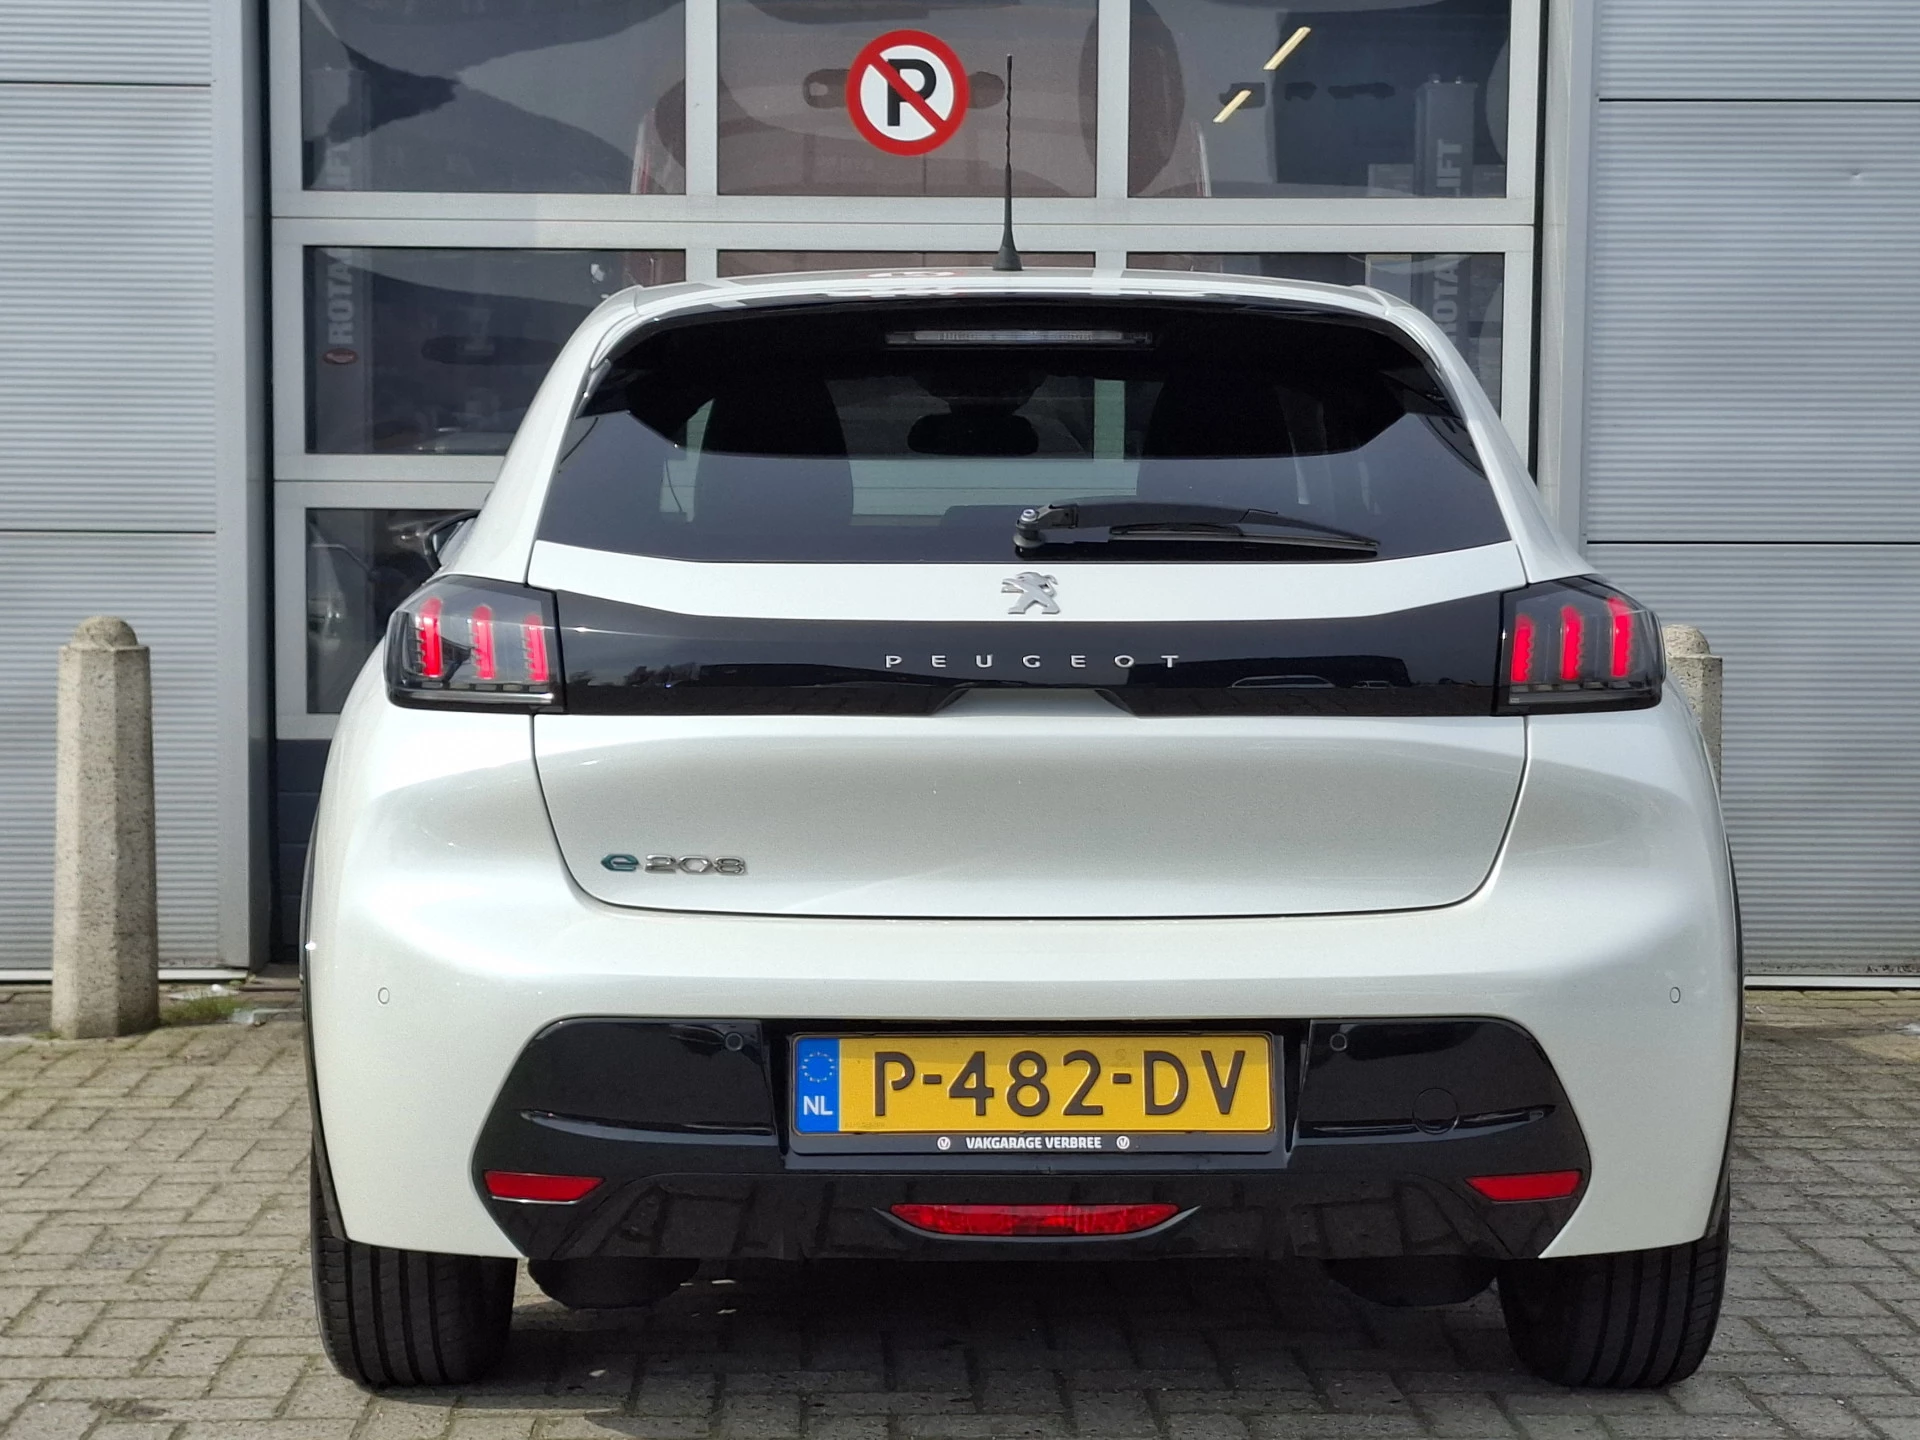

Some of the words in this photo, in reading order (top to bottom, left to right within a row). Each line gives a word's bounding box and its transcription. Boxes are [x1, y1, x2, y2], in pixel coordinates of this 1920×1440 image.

[1436, 138, 1463, 196] IFT
[884, 653, 1180, 669] PEUGEOT
[873, 1049, 1247, 1118] P-482-DV
[802, 1094, 834, 1116] NL
[965, 1136, 1043, 1150] VAKGARAGE
[1045, 1136, 1102, 1149] VERBREE
